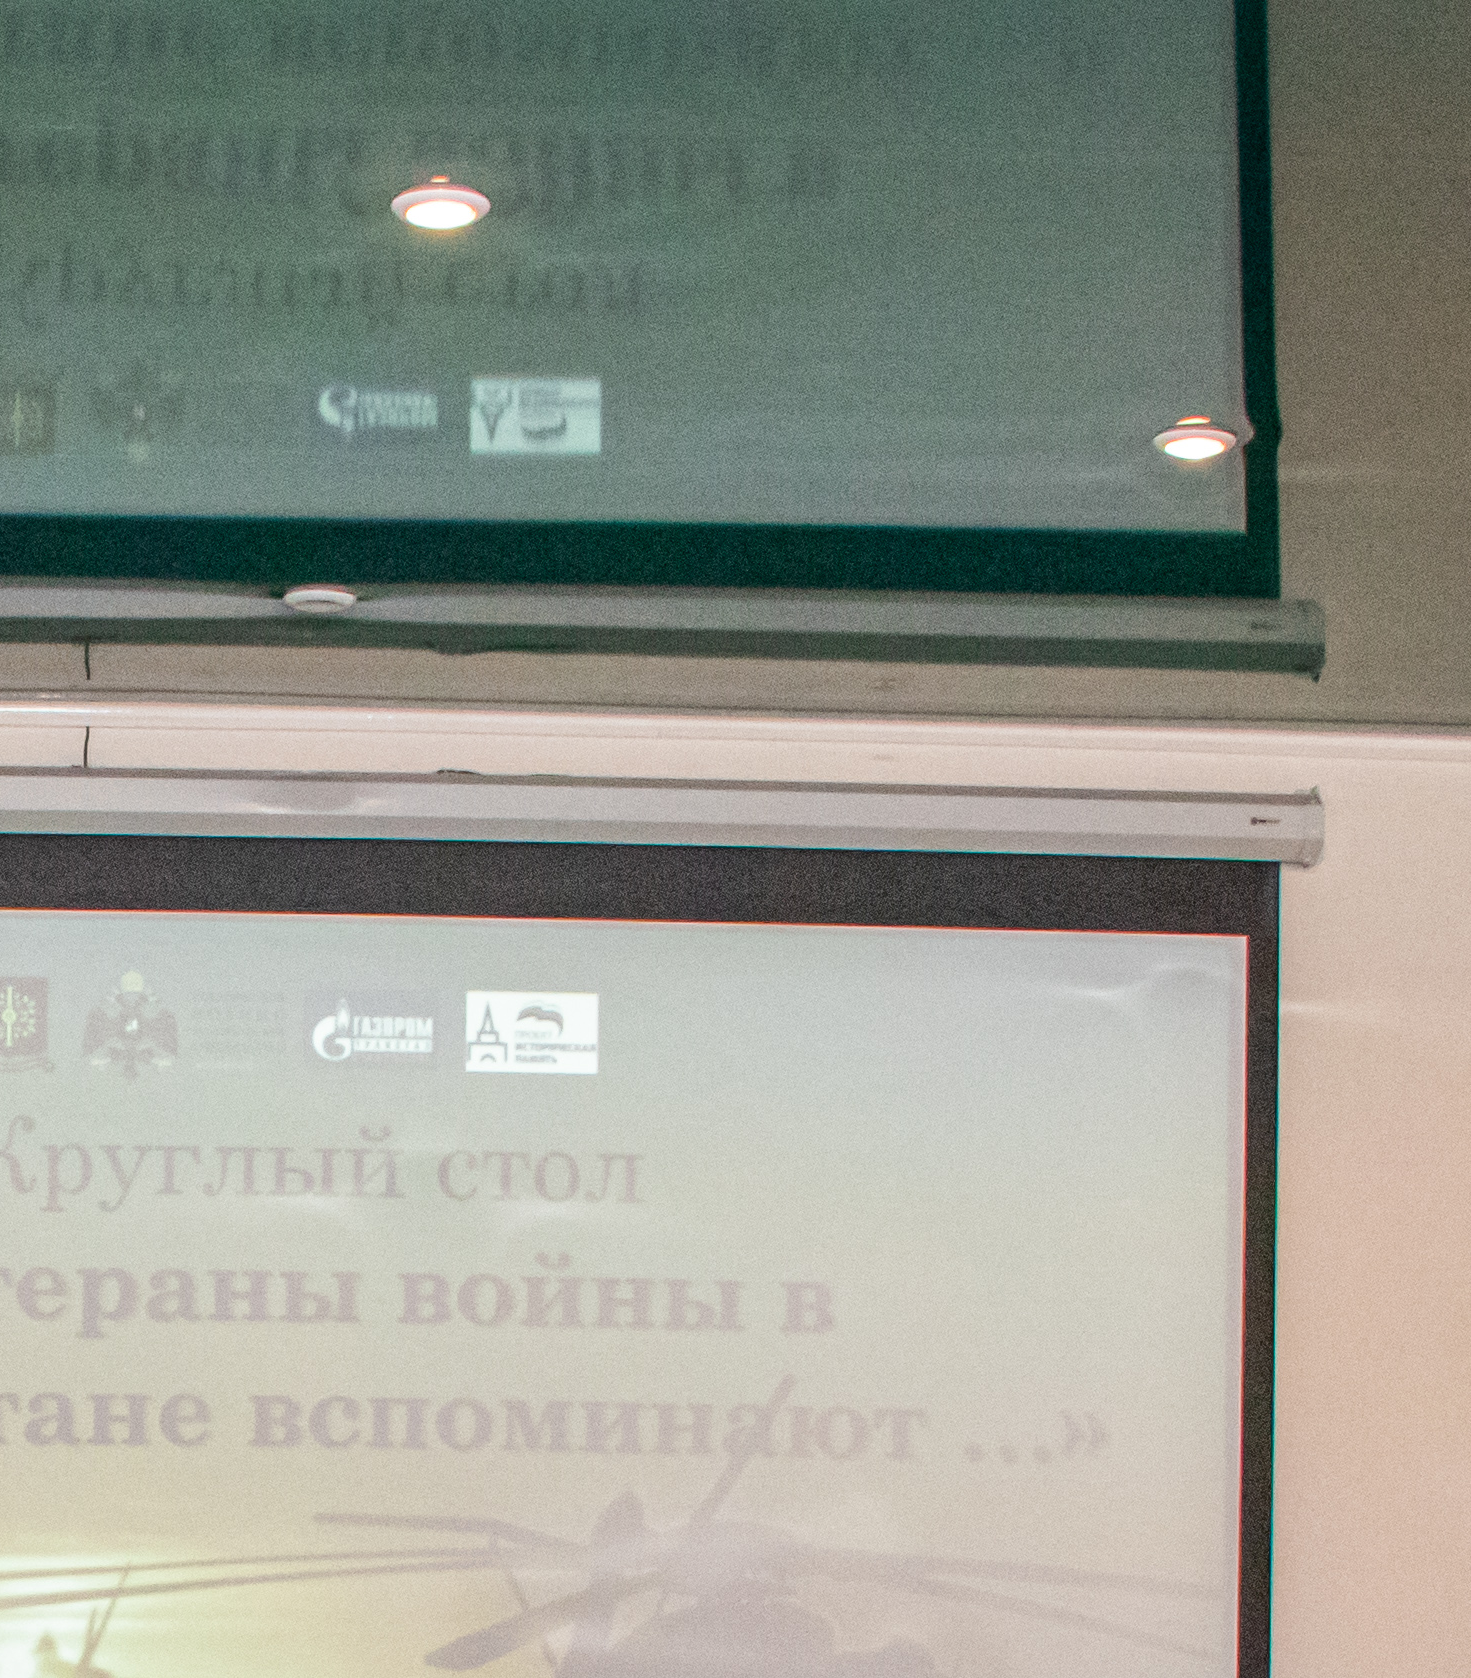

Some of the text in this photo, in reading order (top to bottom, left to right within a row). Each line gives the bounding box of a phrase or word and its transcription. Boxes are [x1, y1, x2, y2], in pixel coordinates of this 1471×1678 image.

[353, 1016, 433, 1037] ГАЗПРОМ
[436, 1146, 646, 1205] стол
[396, 1252, 746, 1332] войны
[781, 1278, 836, 1336] в
[248, 1390, 930, 1463] вспоминают
